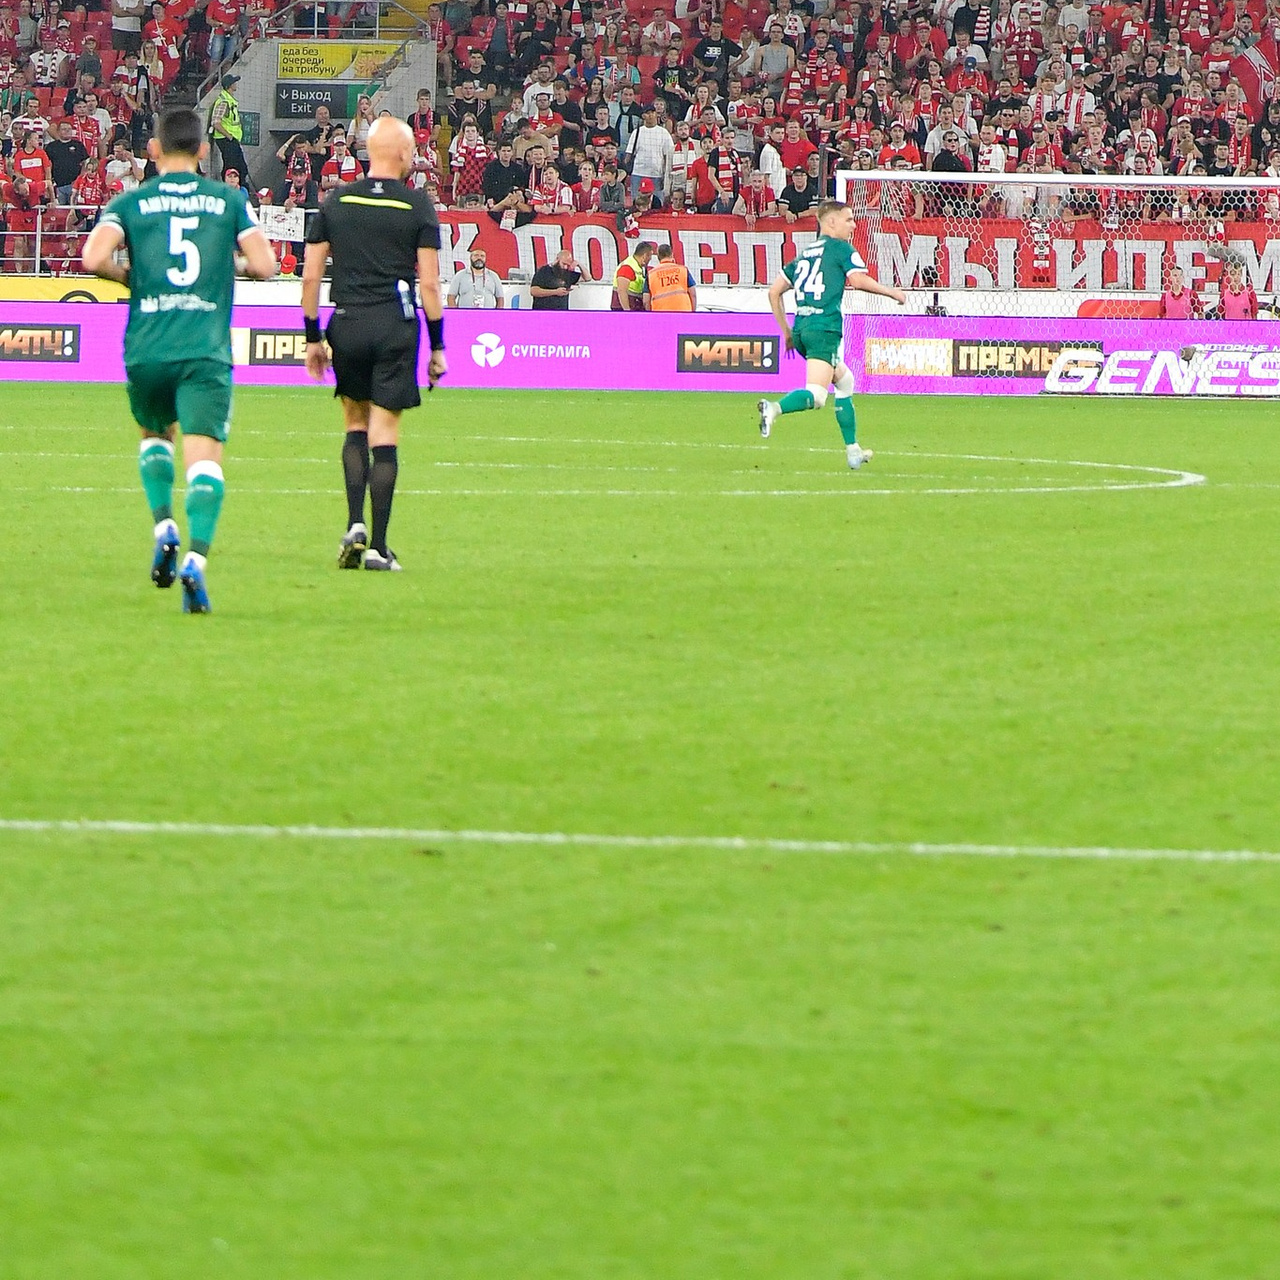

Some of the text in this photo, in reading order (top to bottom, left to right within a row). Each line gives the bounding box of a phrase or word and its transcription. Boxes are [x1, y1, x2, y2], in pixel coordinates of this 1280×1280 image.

[282, 46, 319, 57] еда без
[282, 57, 325, 66] очереди
[295, 65, 337, 75] трибуну
[291, 89, 331, 101] Выход
[291, 103, 312, 113] Exit
[166, 215, 201, 287] 5
[873, 232, 1018, 289] МЫ
[659, 274, 681, 288] T265
[794, 257, 826, 301] 24
[511, 339, 774, 369] СУПЕРЛИГА МАТЧ!
